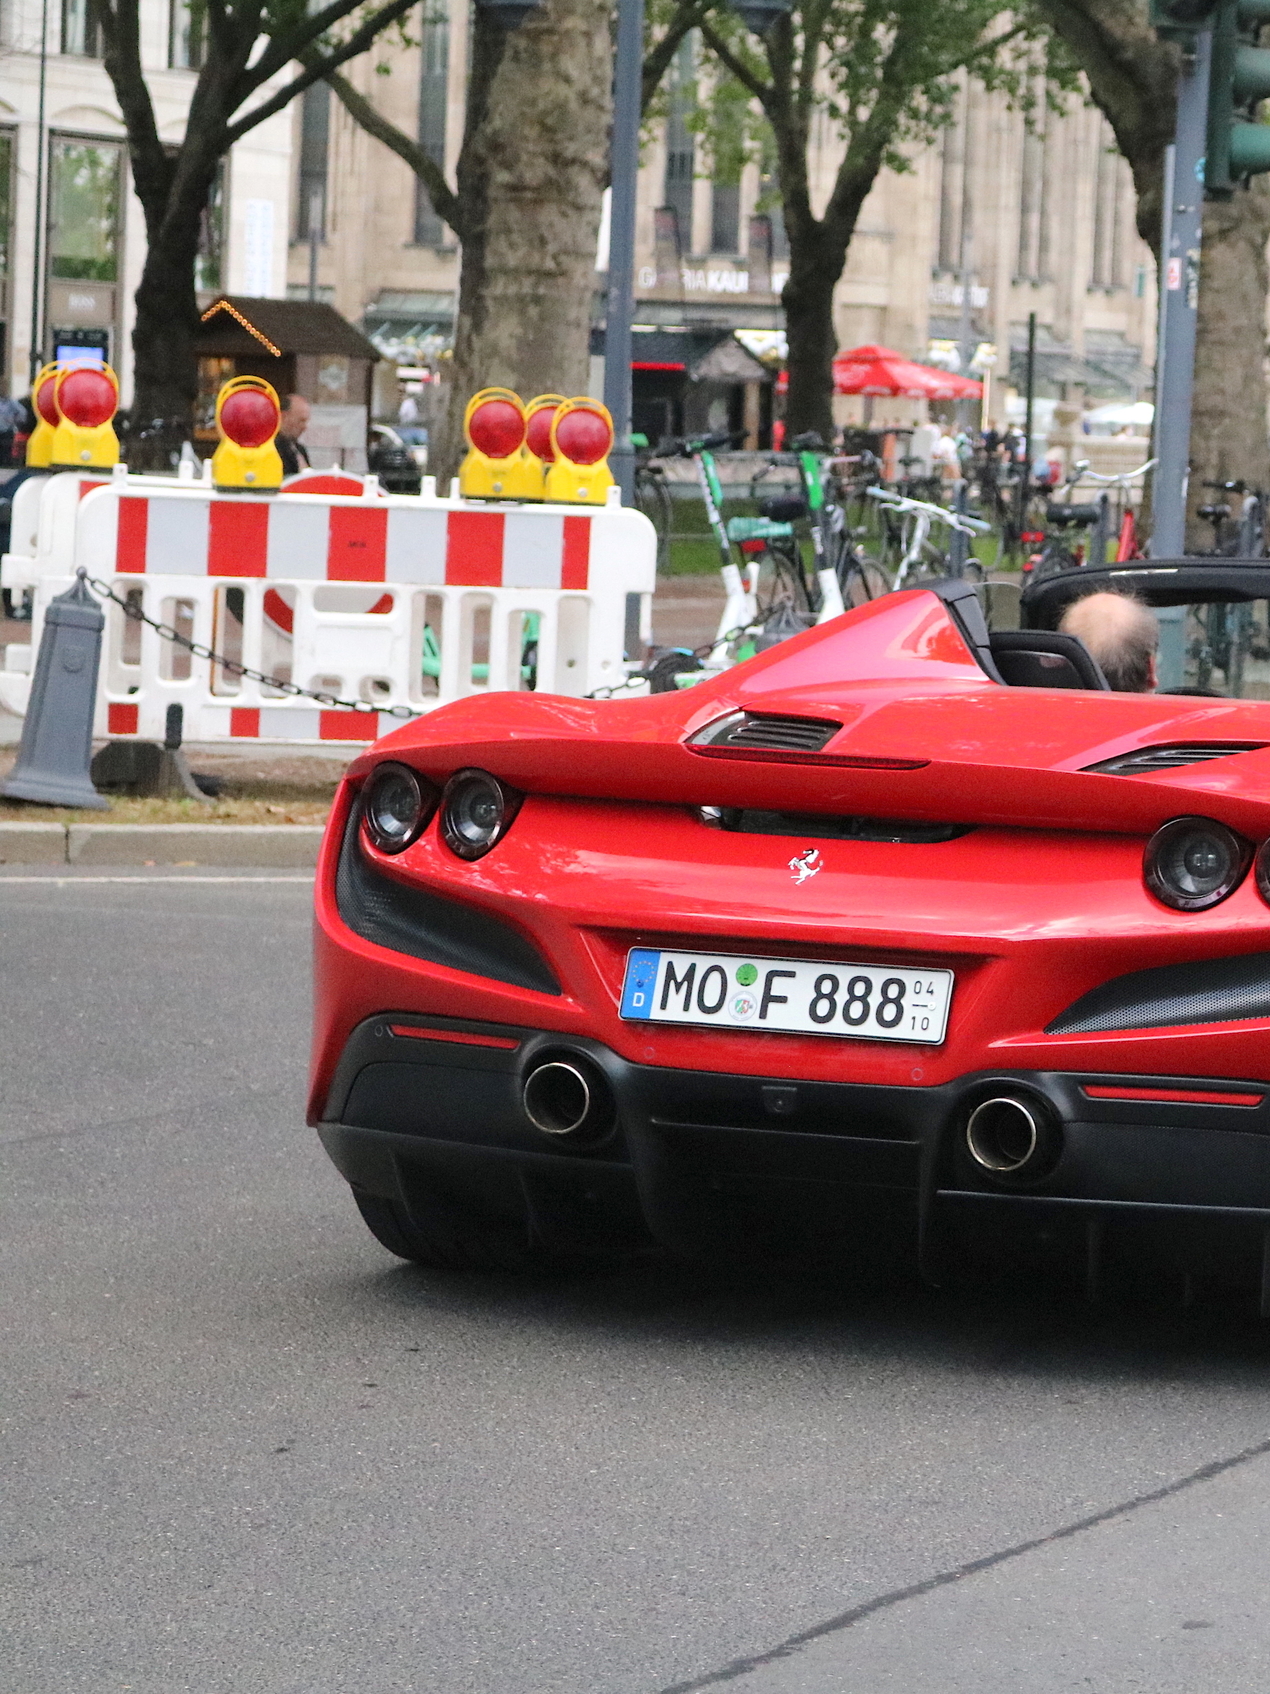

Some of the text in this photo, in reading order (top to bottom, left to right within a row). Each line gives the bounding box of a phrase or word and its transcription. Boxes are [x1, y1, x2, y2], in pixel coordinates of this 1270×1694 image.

[660, 960, 907, 1030] MO F 888
[913, 980, 935, 996] 04
[632, 992, 645, 1008] D
[910, 1016, 931, 1032] 10
